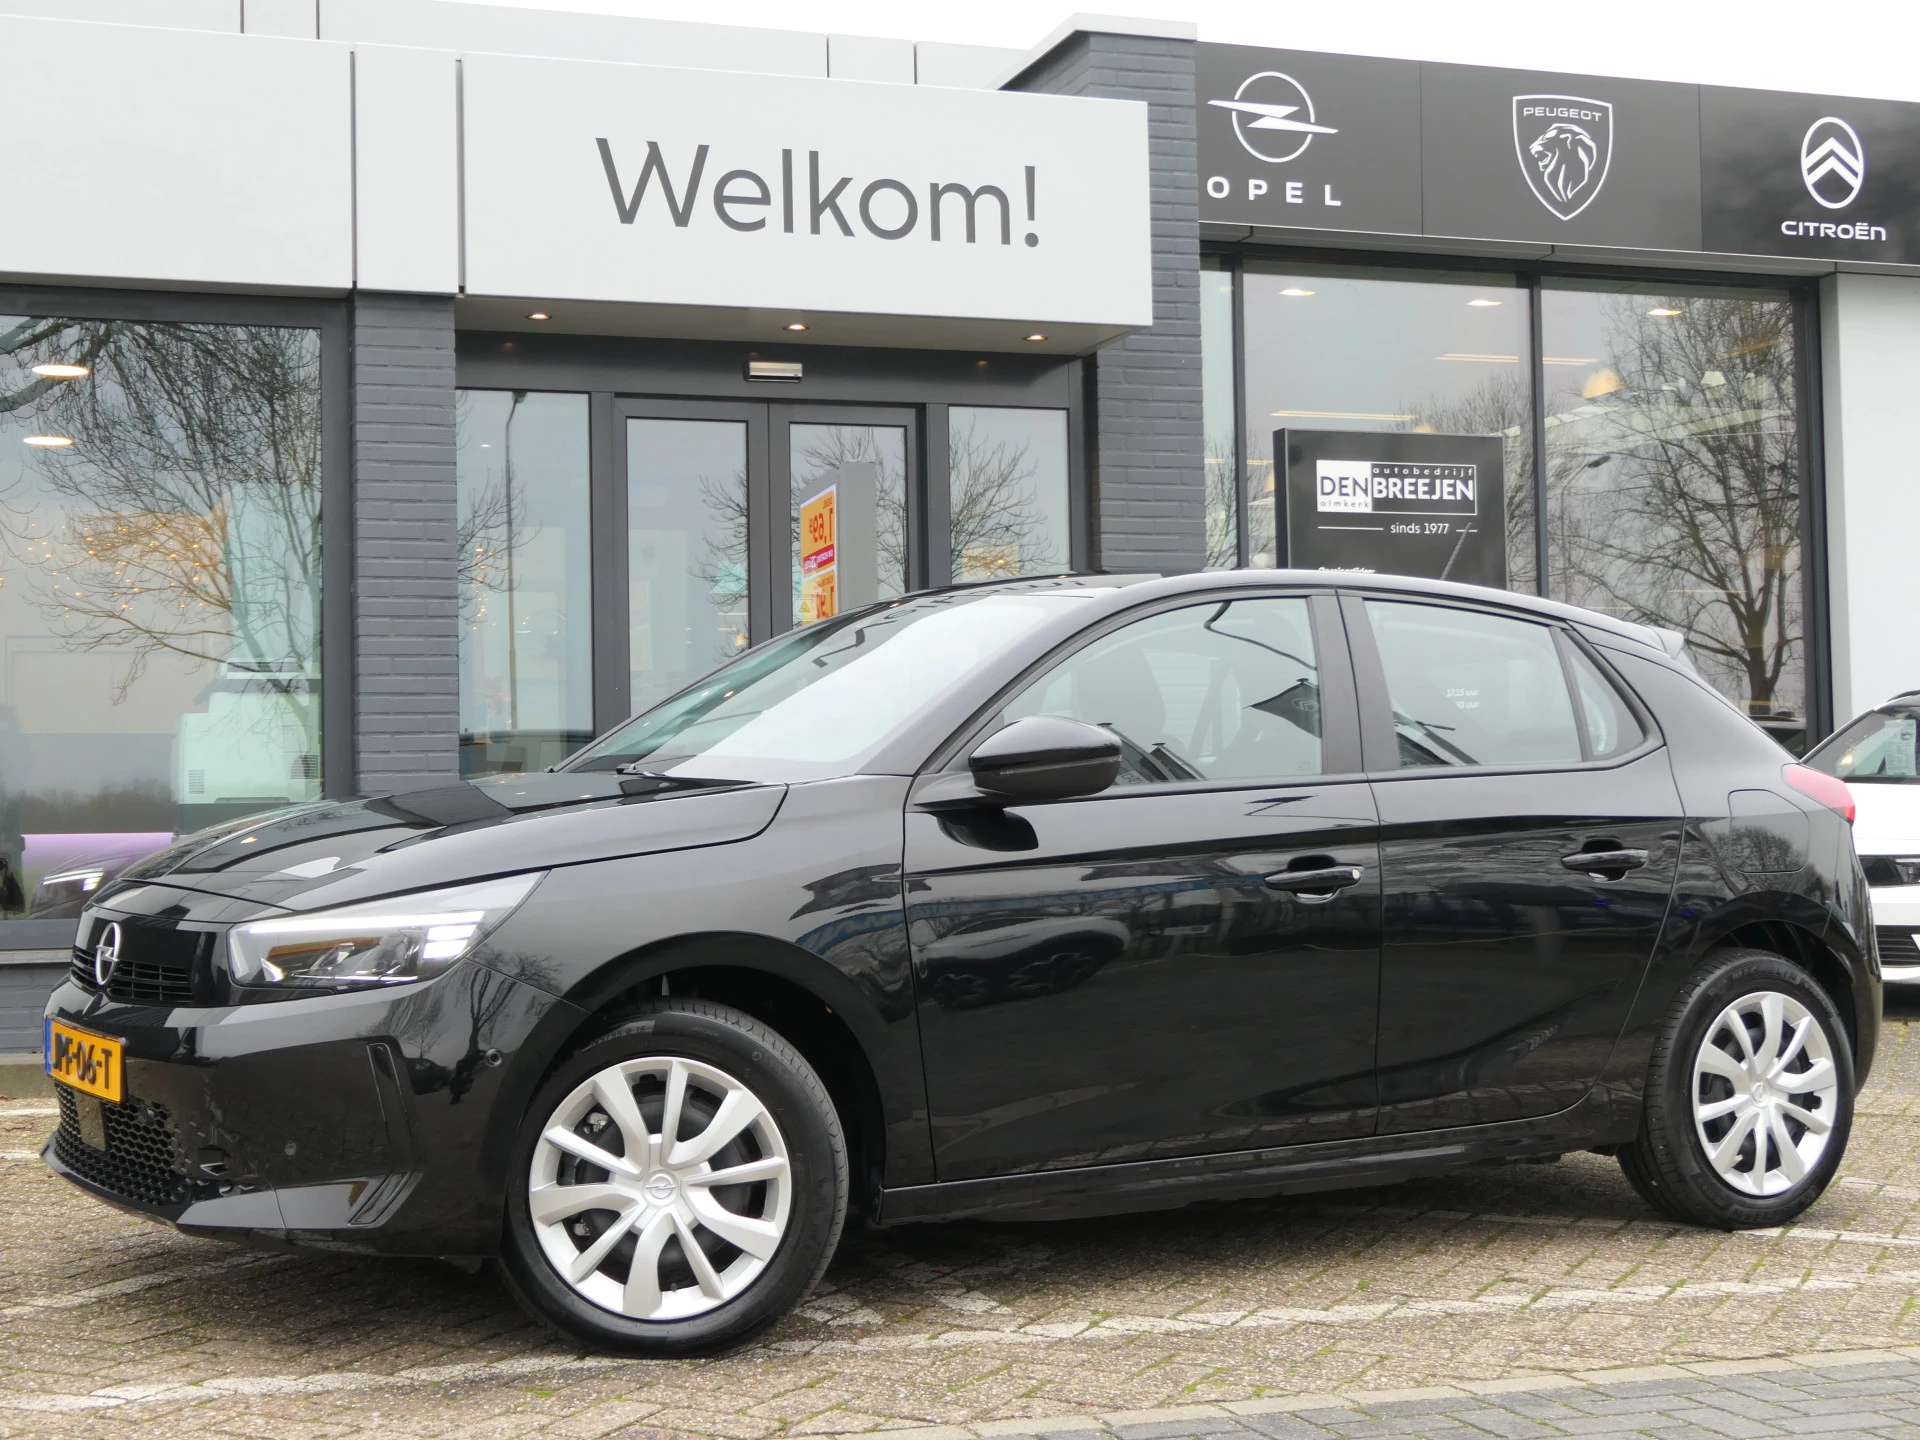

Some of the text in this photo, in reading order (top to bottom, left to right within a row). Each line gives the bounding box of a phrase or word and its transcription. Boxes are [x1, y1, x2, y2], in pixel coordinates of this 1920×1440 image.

[1523, 106, 1602, 122] PEUGEOT
[595, 137, 1039, 248] Welkom!
[1206, 175, 1342, 207] OPEL
[1372, 466, 1474, 478] autobedrijf
[1320, 475, 1475, 501] DEN BREEJEN
[1320, 499, 1371, 509] almkerk
[1390, 522, 1450, 535] sinds 1977
